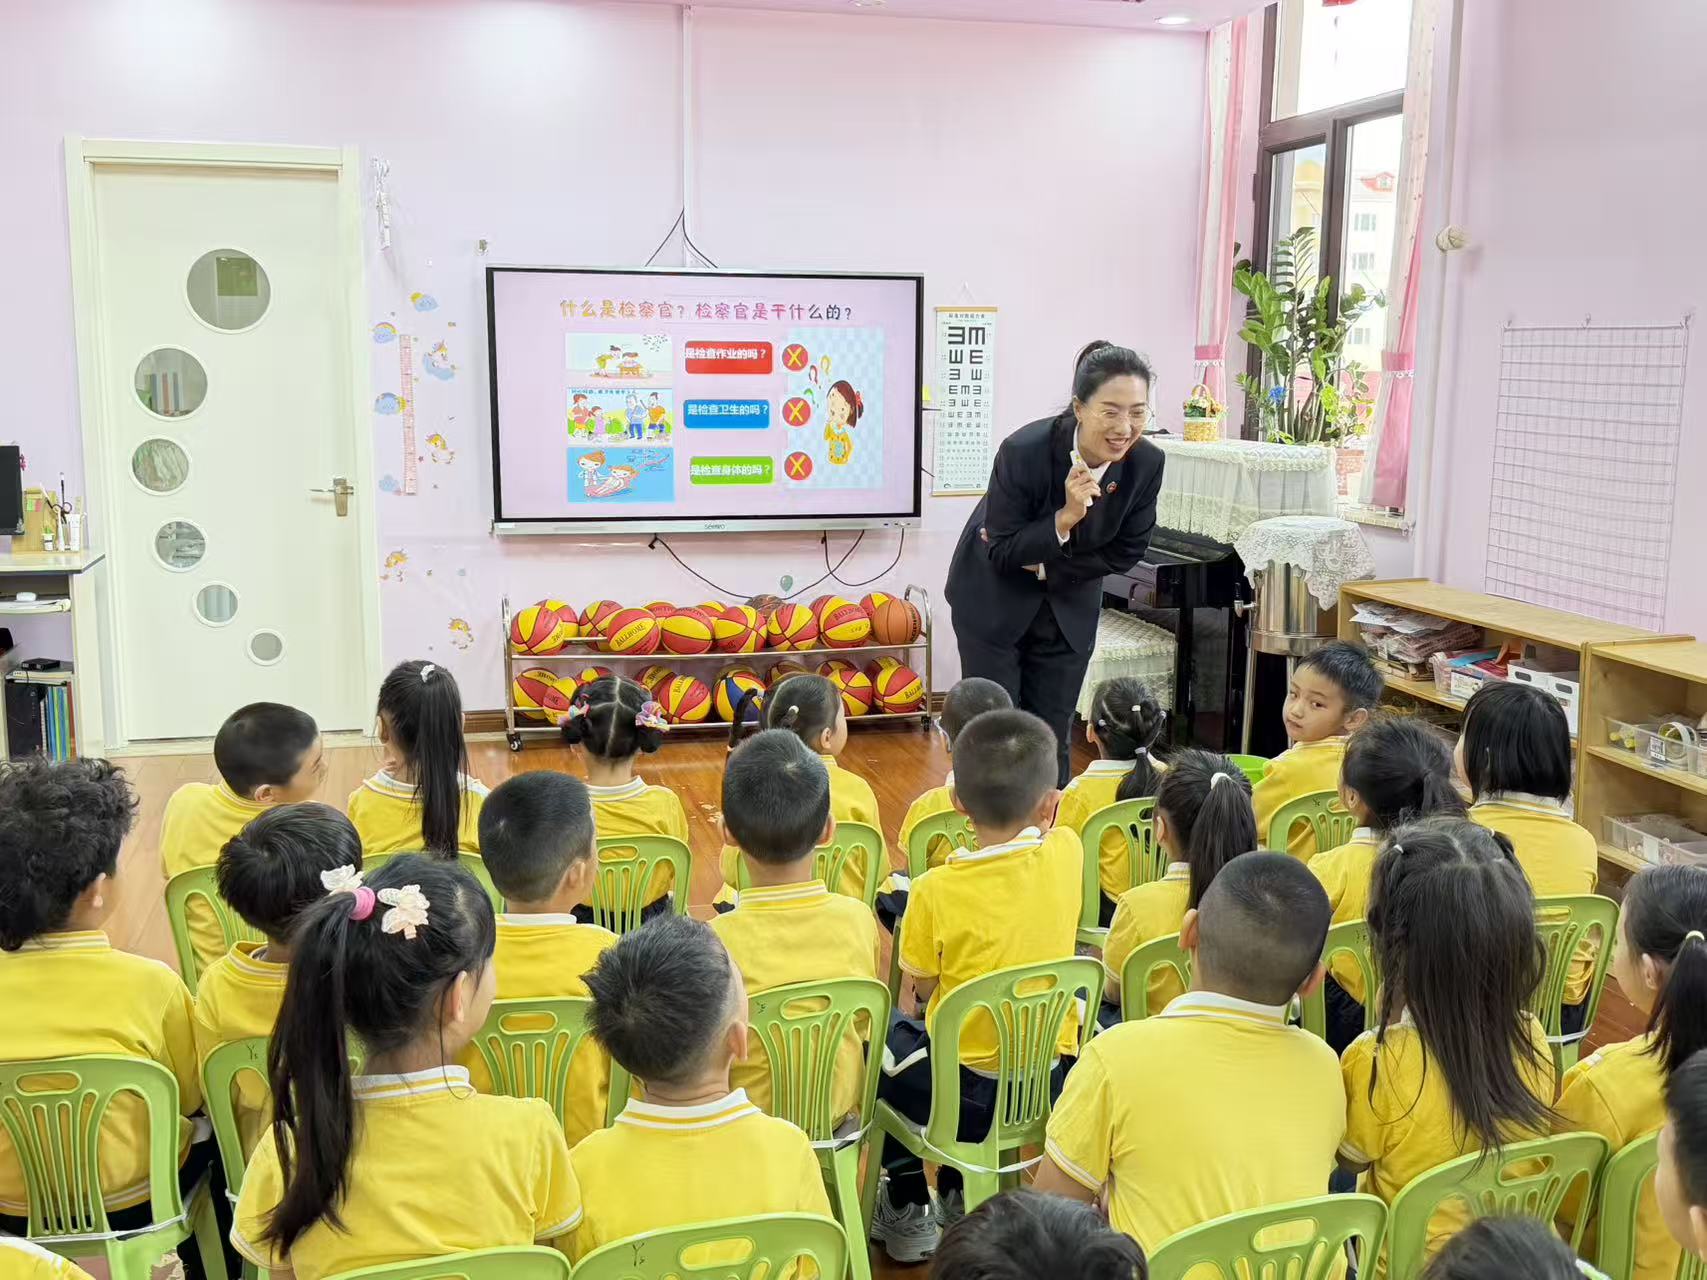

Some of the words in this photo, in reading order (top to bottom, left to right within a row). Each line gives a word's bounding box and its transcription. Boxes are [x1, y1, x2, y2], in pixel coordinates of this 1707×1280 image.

[687, 403, 769, 416] 是检查卫生的吗？
